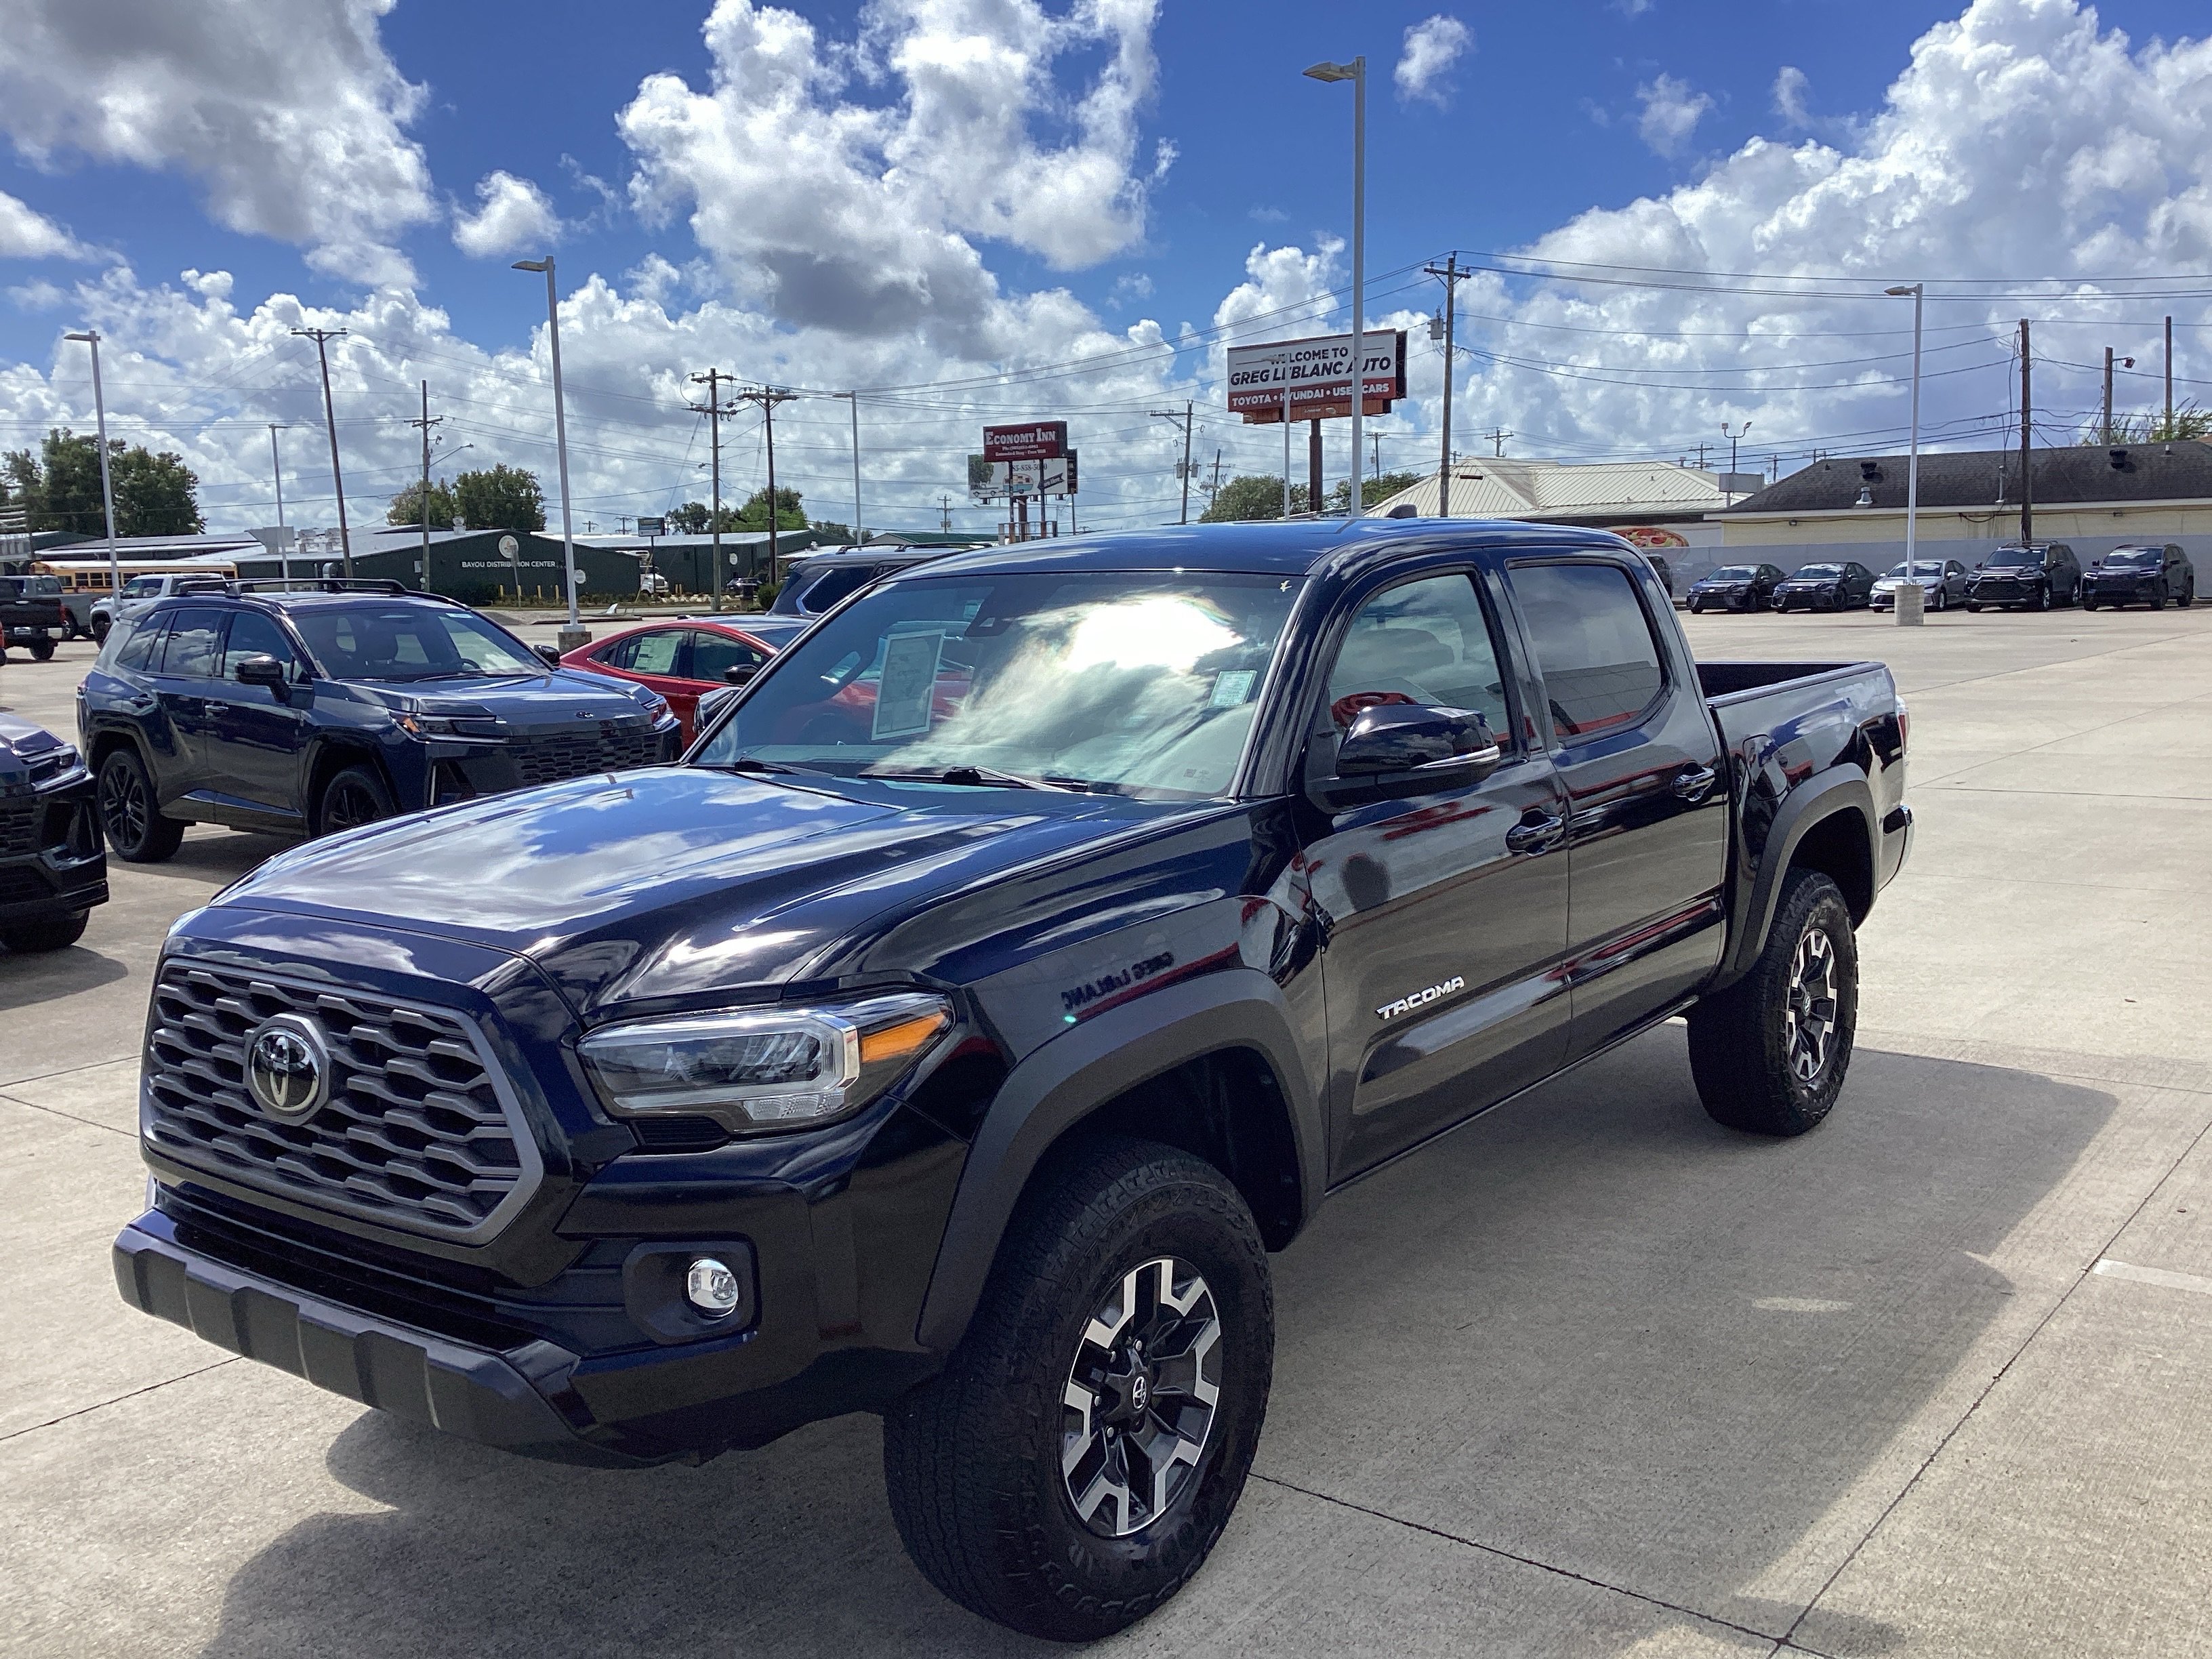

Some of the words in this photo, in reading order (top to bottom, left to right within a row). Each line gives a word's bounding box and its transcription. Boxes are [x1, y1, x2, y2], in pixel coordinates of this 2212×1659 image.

[1332, 346, 1349, 358] TO
[1231, 369, 1270, 386] GREG
[1232, 394, 1272, 406] TOYOTA
[1332, 385, 1354, 396] USE
[1361, 383, 1389, 394] CARS
[1375, 975, 1465, 1020] TACOMA
